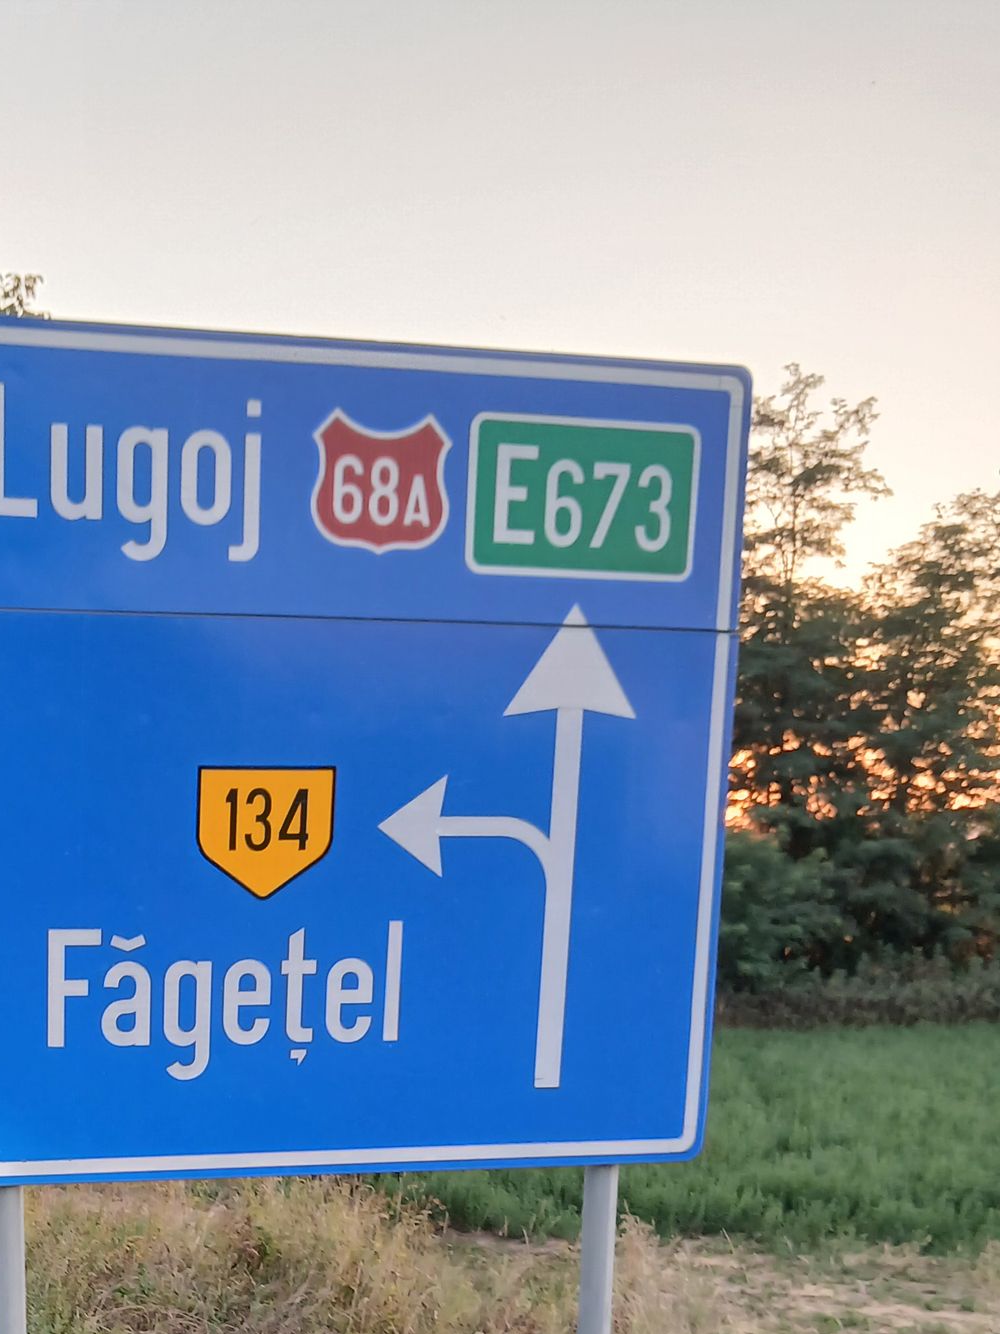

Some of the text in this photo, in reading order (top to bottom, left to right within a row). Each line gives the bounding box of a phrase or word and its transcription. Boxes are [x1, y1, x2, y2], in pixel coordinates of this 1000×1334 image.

[332, 453, 432, 528] 68A
[492, 443, 673, 553] E673
[225, 787, 309, 852] 134
[47, 920, 403, 1081] Făgețel
